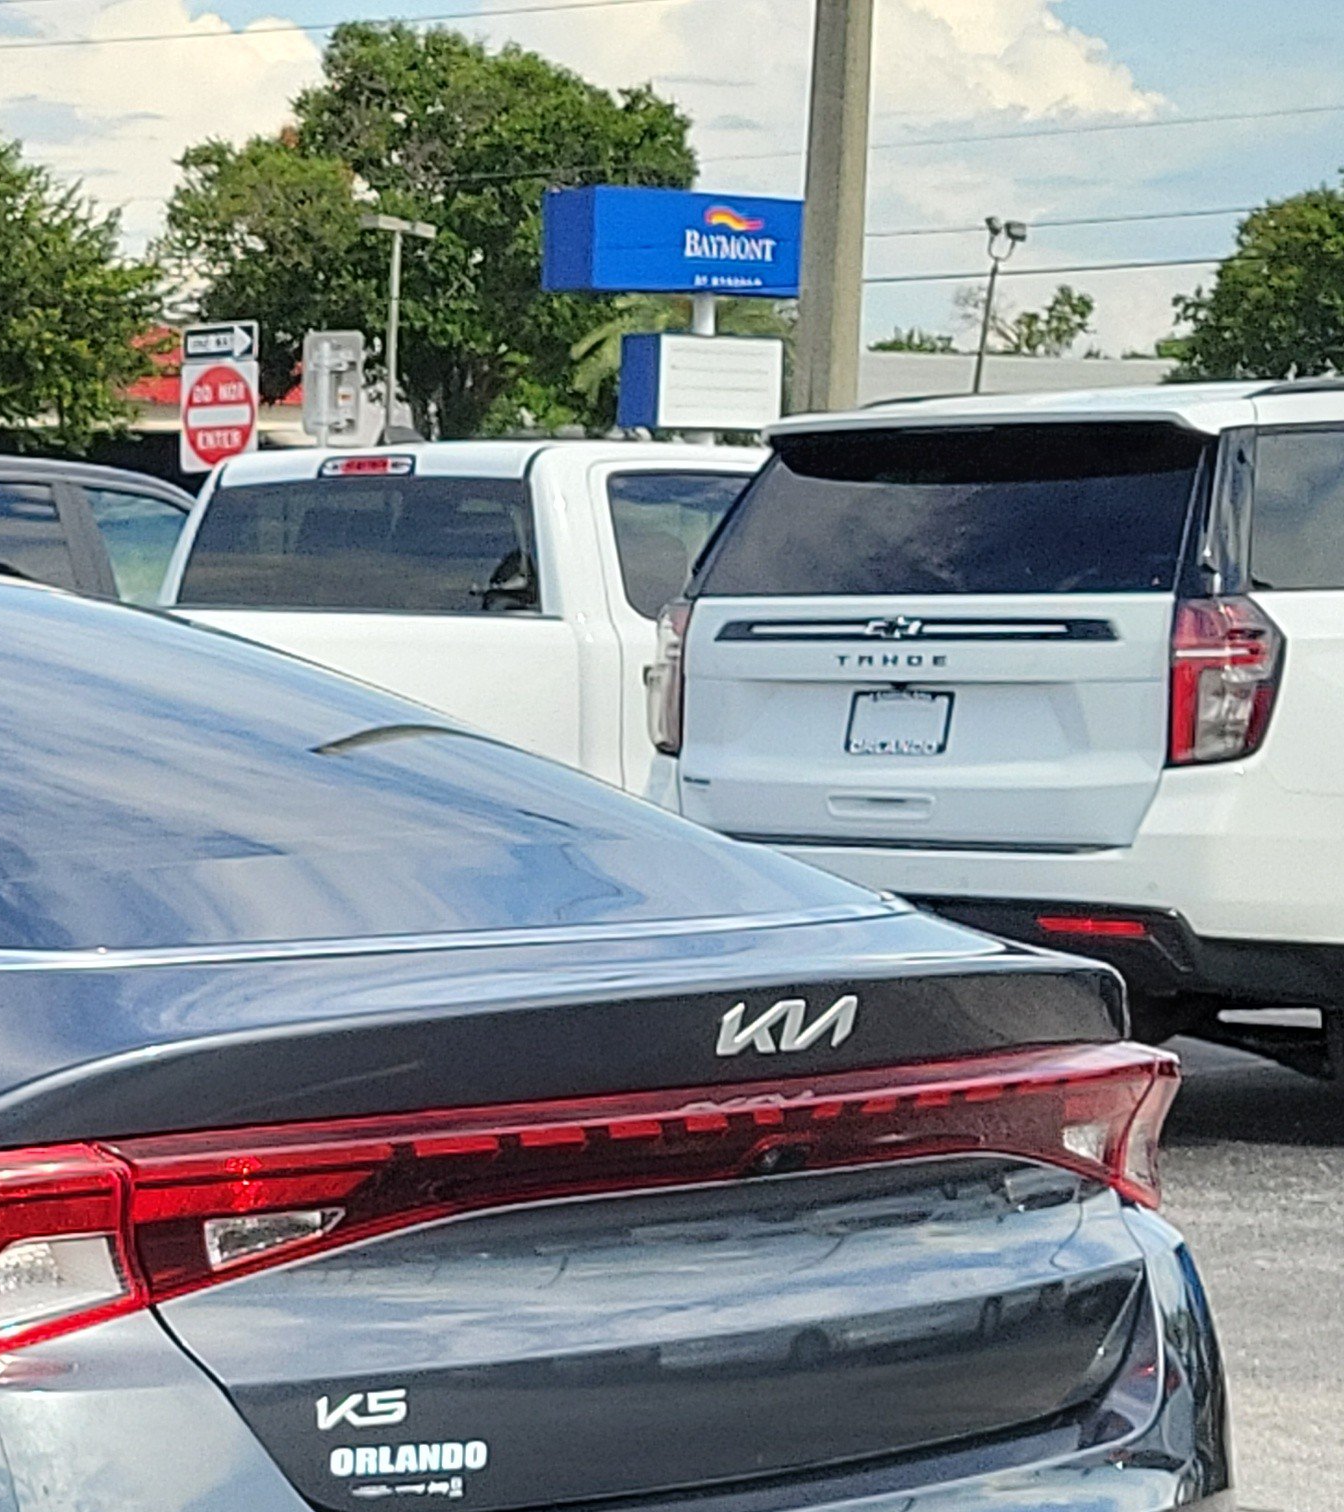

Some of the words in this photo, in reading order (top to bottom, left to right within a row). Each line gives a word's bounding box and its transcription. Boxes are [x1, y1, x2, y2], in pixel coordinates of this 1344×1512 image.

[684, 229, 777, 263] BAYMONT
[193, 384, 211, 403] DO
[219, 382, 245, 400] NOT
[196, 430, 242, 450] ENTER
[837, 654, 947, 667] TAHOE
[850, 739, 938, 754] ORLANDO
[716, 995, 858, 1056] KIA
[316, 1388, 407, 1430] K5
[329, 1440, 488, 1477] ORLANDO
